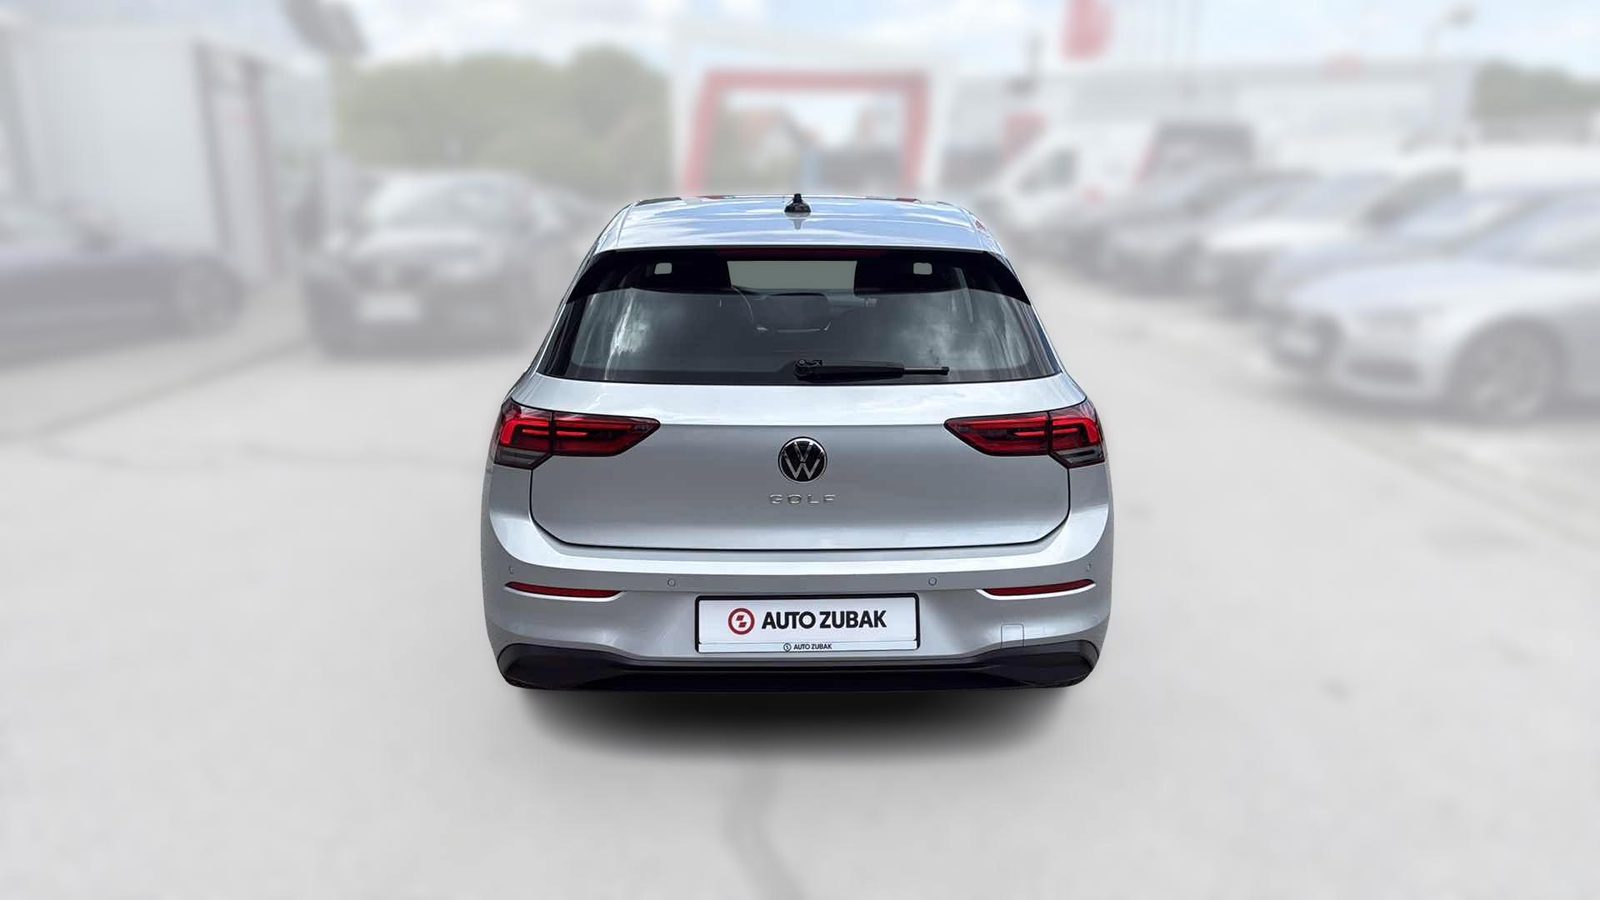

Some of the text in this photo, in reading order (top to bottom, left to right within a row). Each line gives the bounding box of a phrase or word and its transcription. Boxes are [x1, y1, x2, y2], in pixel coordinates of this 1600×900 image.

[769, 494, 837, 505] GOLF
[762, 610, 887, 630] AUTO ZUBAK
